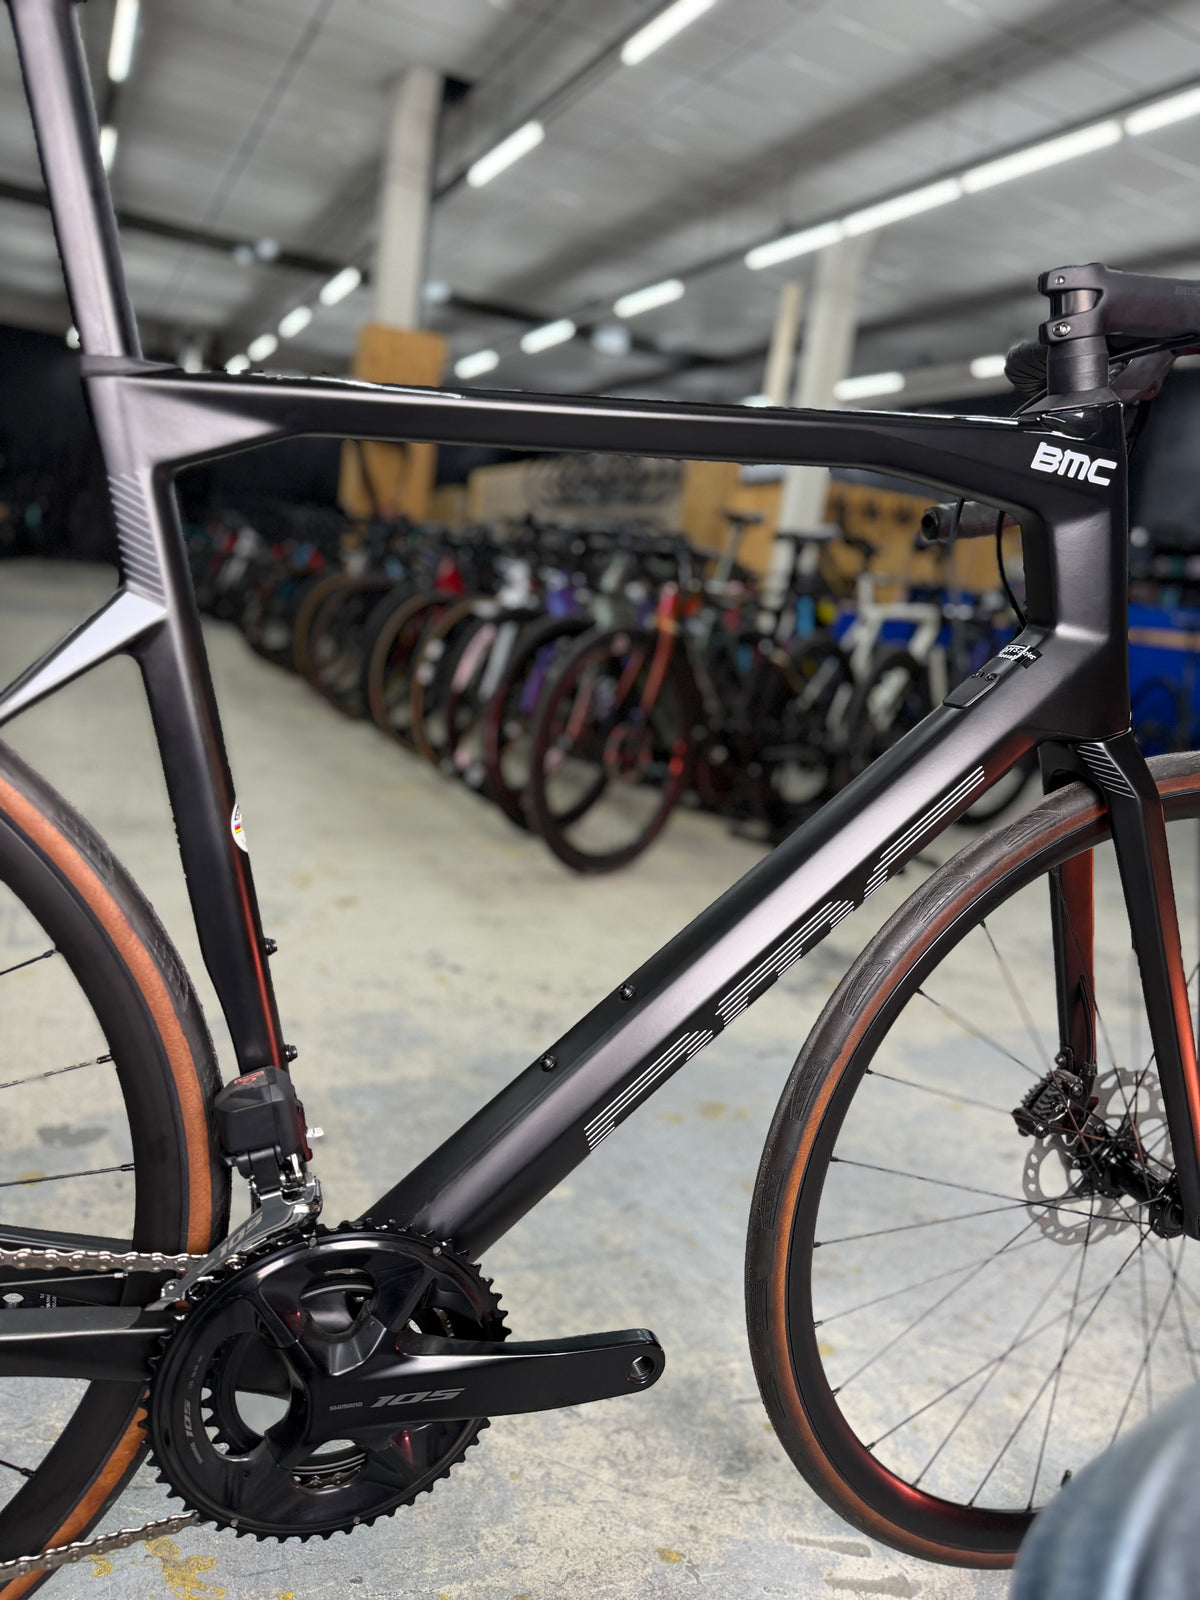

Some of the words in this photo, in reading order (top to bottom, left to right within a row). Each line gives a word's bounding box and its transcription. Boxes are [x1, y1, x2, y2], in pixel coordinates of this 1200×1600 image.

[1030, 441, 1118, 487] BMC
[219, 1212, 264, 1258] 105
[328, 1401, 363, 1411] SHIMANO
[370, 1387, 466, 1408] 105
